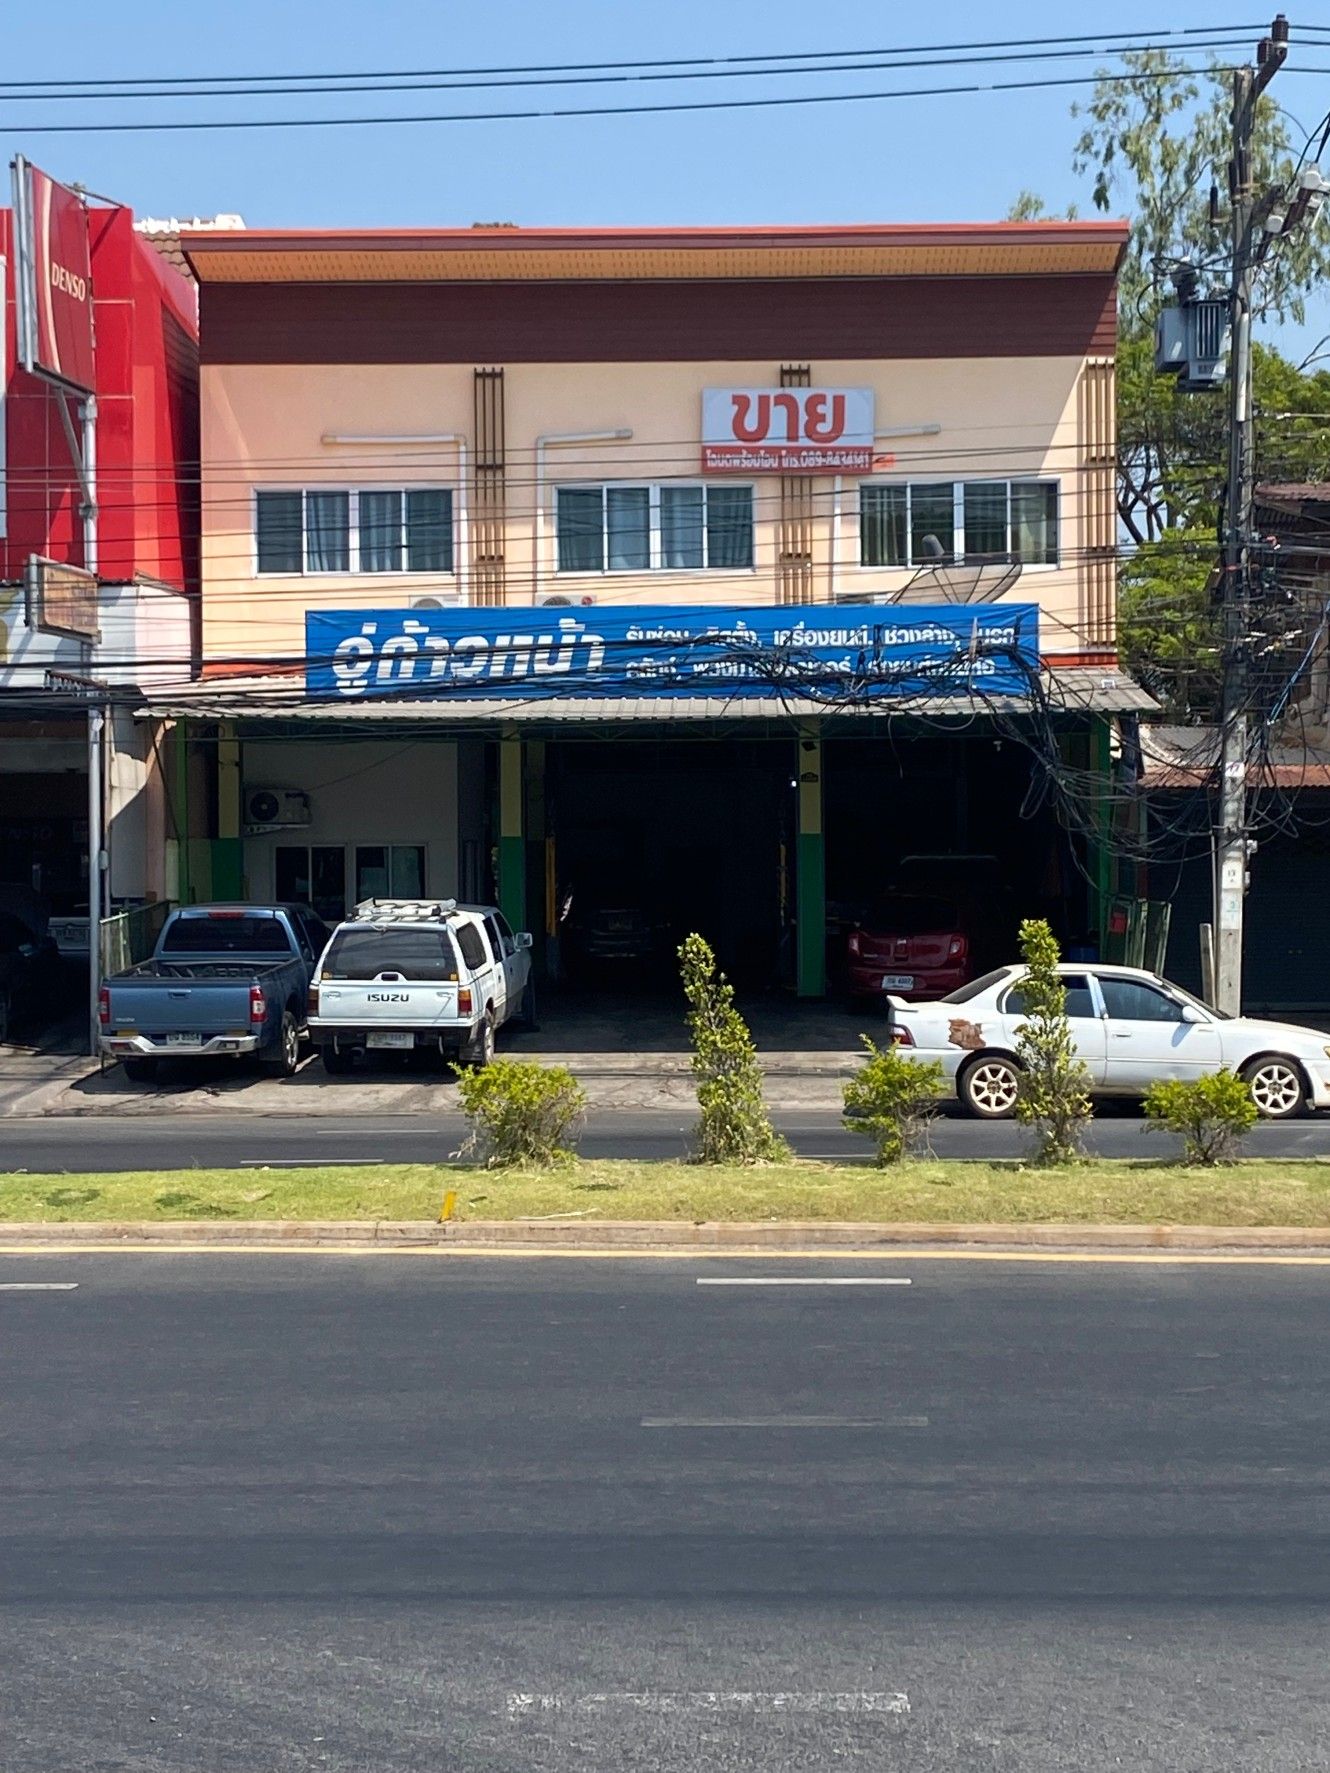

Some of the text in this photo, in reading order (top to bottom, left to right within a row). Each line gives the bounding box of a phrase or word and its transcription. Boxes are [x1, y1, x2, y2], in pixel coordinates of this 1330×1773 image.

[52, 261, 86, 302] DENSO
[732, 393, 846, 444] ขาย
[332, 617, 607, 695] อู่ก้าวหน้า
[367, 993, 410, 1002] ISUZU
